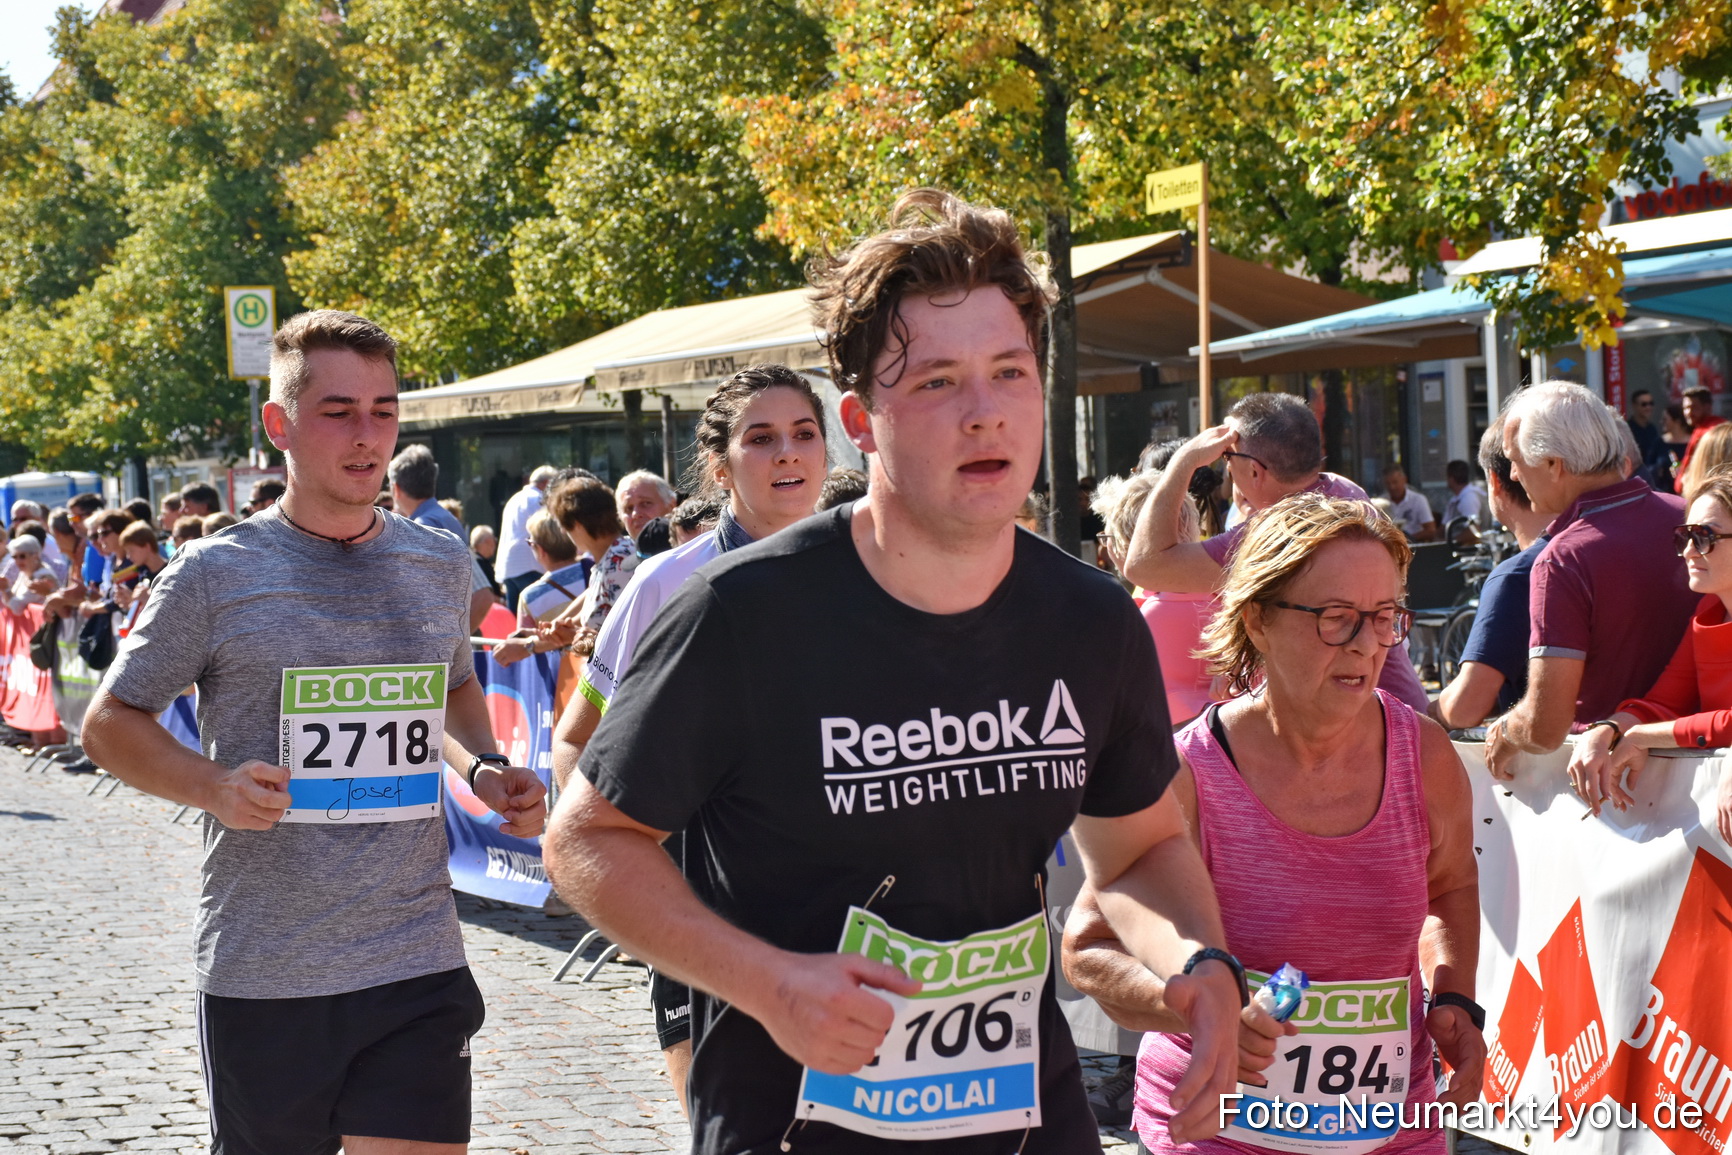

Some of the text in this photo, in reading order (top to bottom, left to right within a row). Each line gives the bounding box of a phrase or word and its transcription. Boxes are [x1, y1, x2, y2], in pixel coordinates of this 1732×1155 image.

[1157, 181, 1199, 200] Toiletten
[1624, 171, 1732, 221] vodafo
[243, 301, 259, 320] H
[1609, 346, 1620, 382] Stor
[296, 672, 434, 708] BOCK
[303, 719, 429, 769] 2718
[821, 699, 1036, 768] Reebok
[327, 776, 403, 820] Josef
[825, 758, 1086, 814] WEIGHTLIFTING
[1022, 992, 1031, 1002] D
[1292, 986, 1400, 1028] OCK
[865, 991, 1018, 1066] 106
[1240, 1044, 1390, 1095] 184
[1397, 1047, 1404, 1056] D
[1487, 1026, 1520, 1097] Braun
[1546, 1019, 1604, 1098] Braun
[1621, 983, 1732, 1123] Braun
[853, 1078, 995, 1116] NICOLAI
[1573, 1081, 1590, 1101] Sicher
